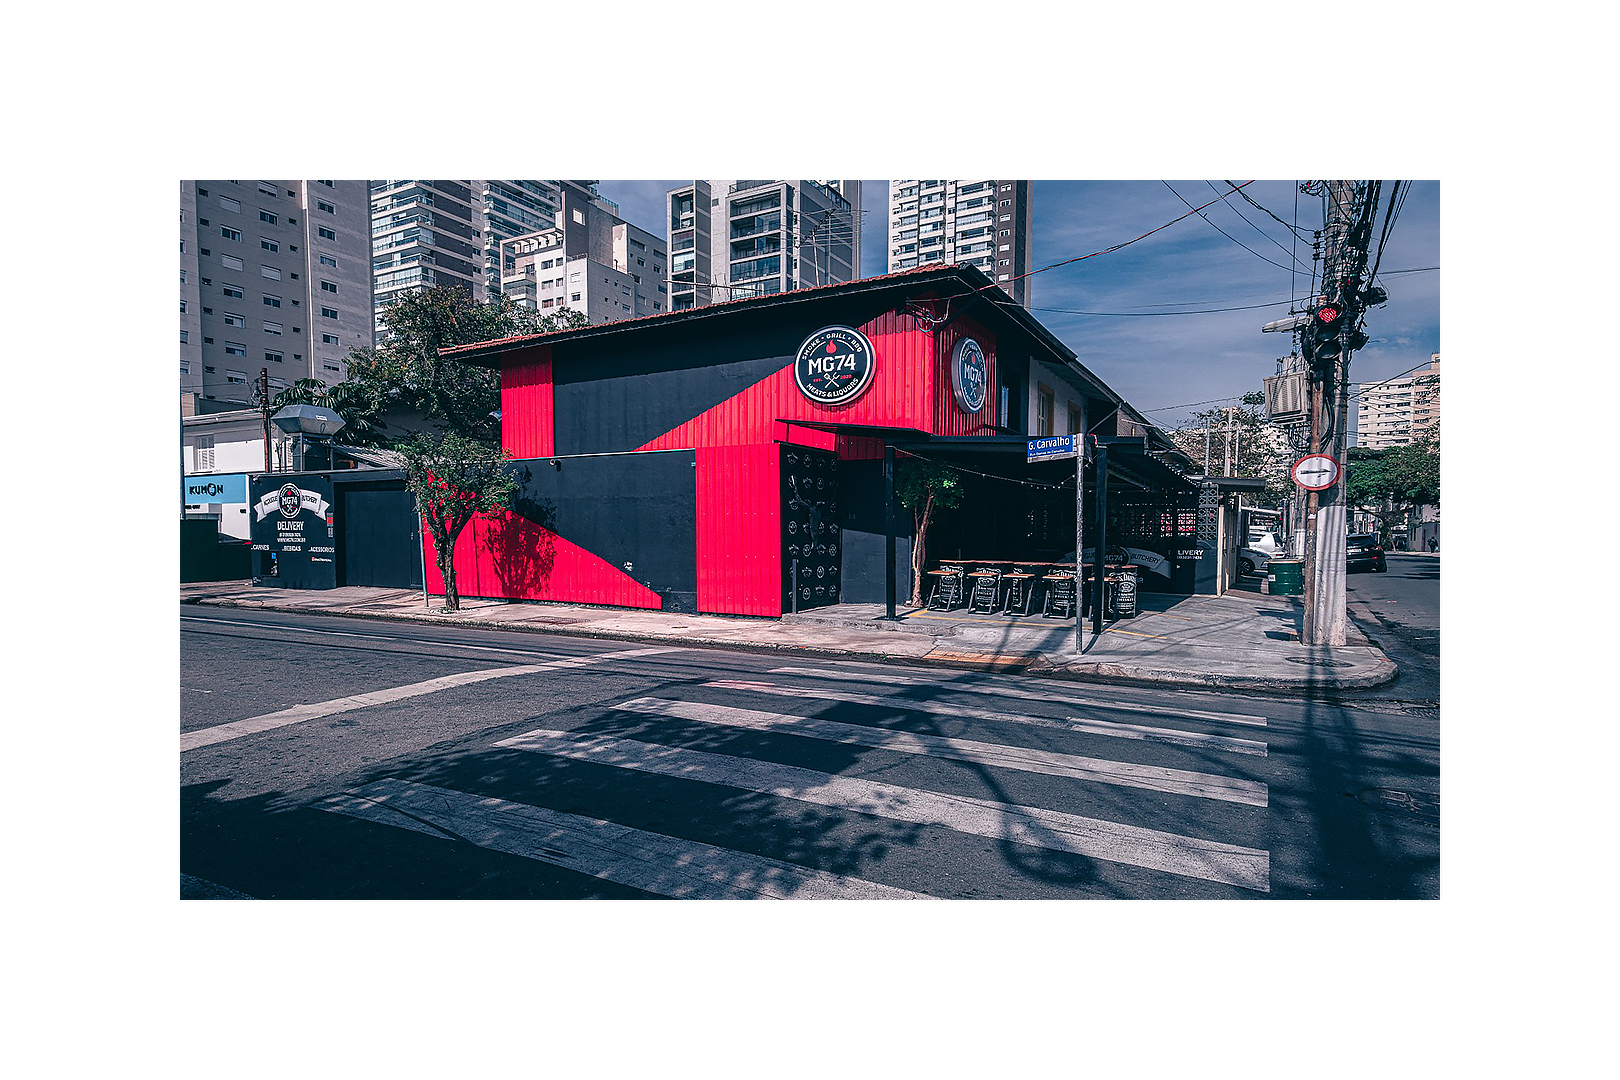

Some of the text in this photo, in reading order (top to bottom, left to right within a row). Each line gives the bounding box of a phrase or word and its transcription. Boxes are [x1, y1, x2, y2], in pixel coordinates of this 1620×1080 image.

[802, 338, 821, 360] SMOKE
[826, 332, 846, 340] GRILL
[808, 353, 856, 376] MG74
[964, 362, 983, 387] MG74
[1036, 436, 1070, 449] Carvalho
[189, 482, 224, 497] KUMON
[277, 521, 304, 530] DELIVERY
[1130, 551, 1161, 565] BUTCHERY
